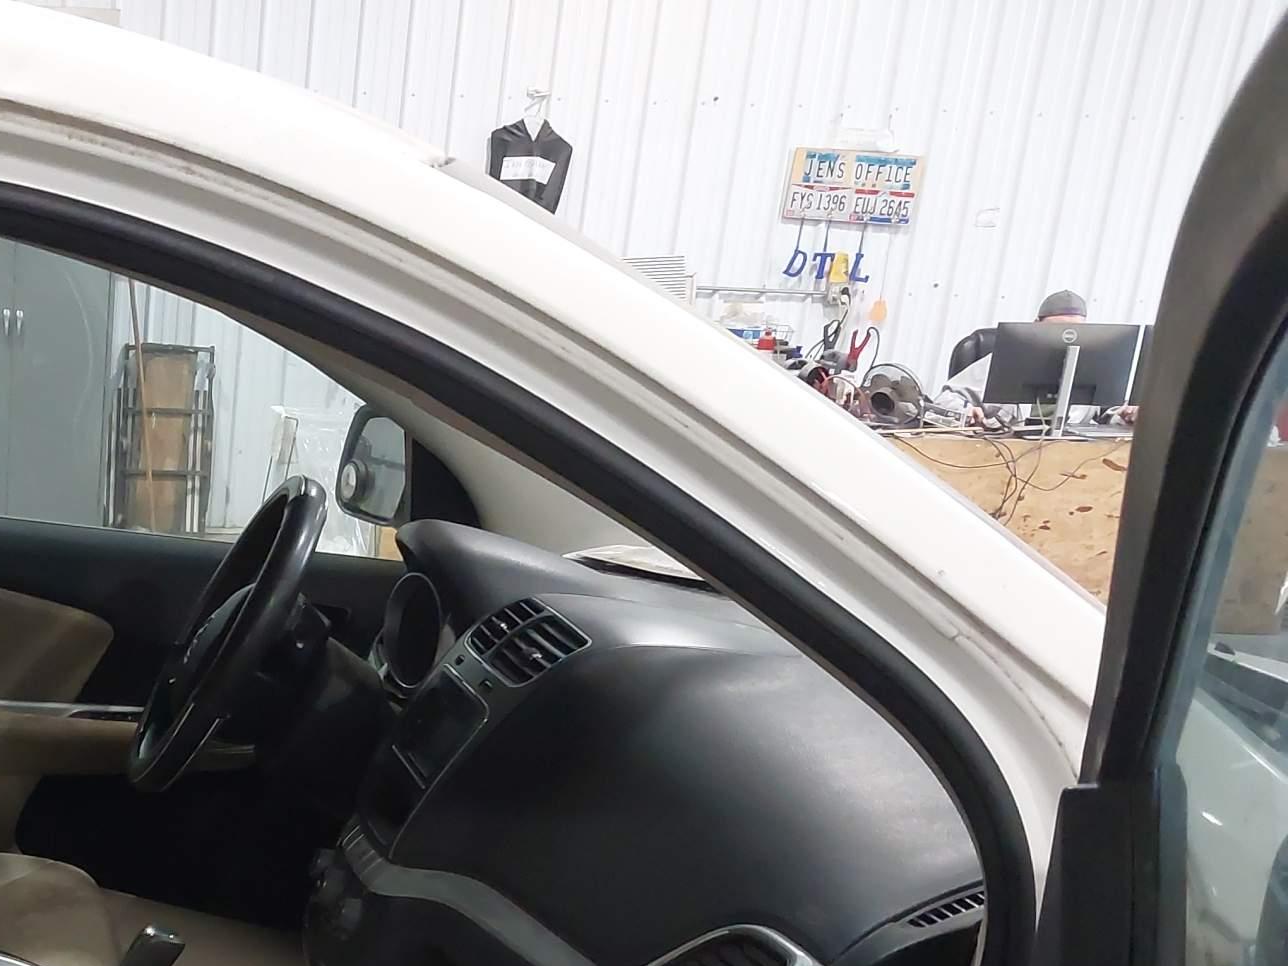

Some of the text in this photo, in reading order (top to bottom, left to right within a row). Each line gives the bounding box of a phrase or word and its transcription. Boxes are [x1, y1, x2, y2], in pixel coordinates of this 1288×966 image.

[804, 159, 914, 183] JENS OFFICE
[816, 193, 847, 212] 1396
[853, 196, 878, 215] EUJ
